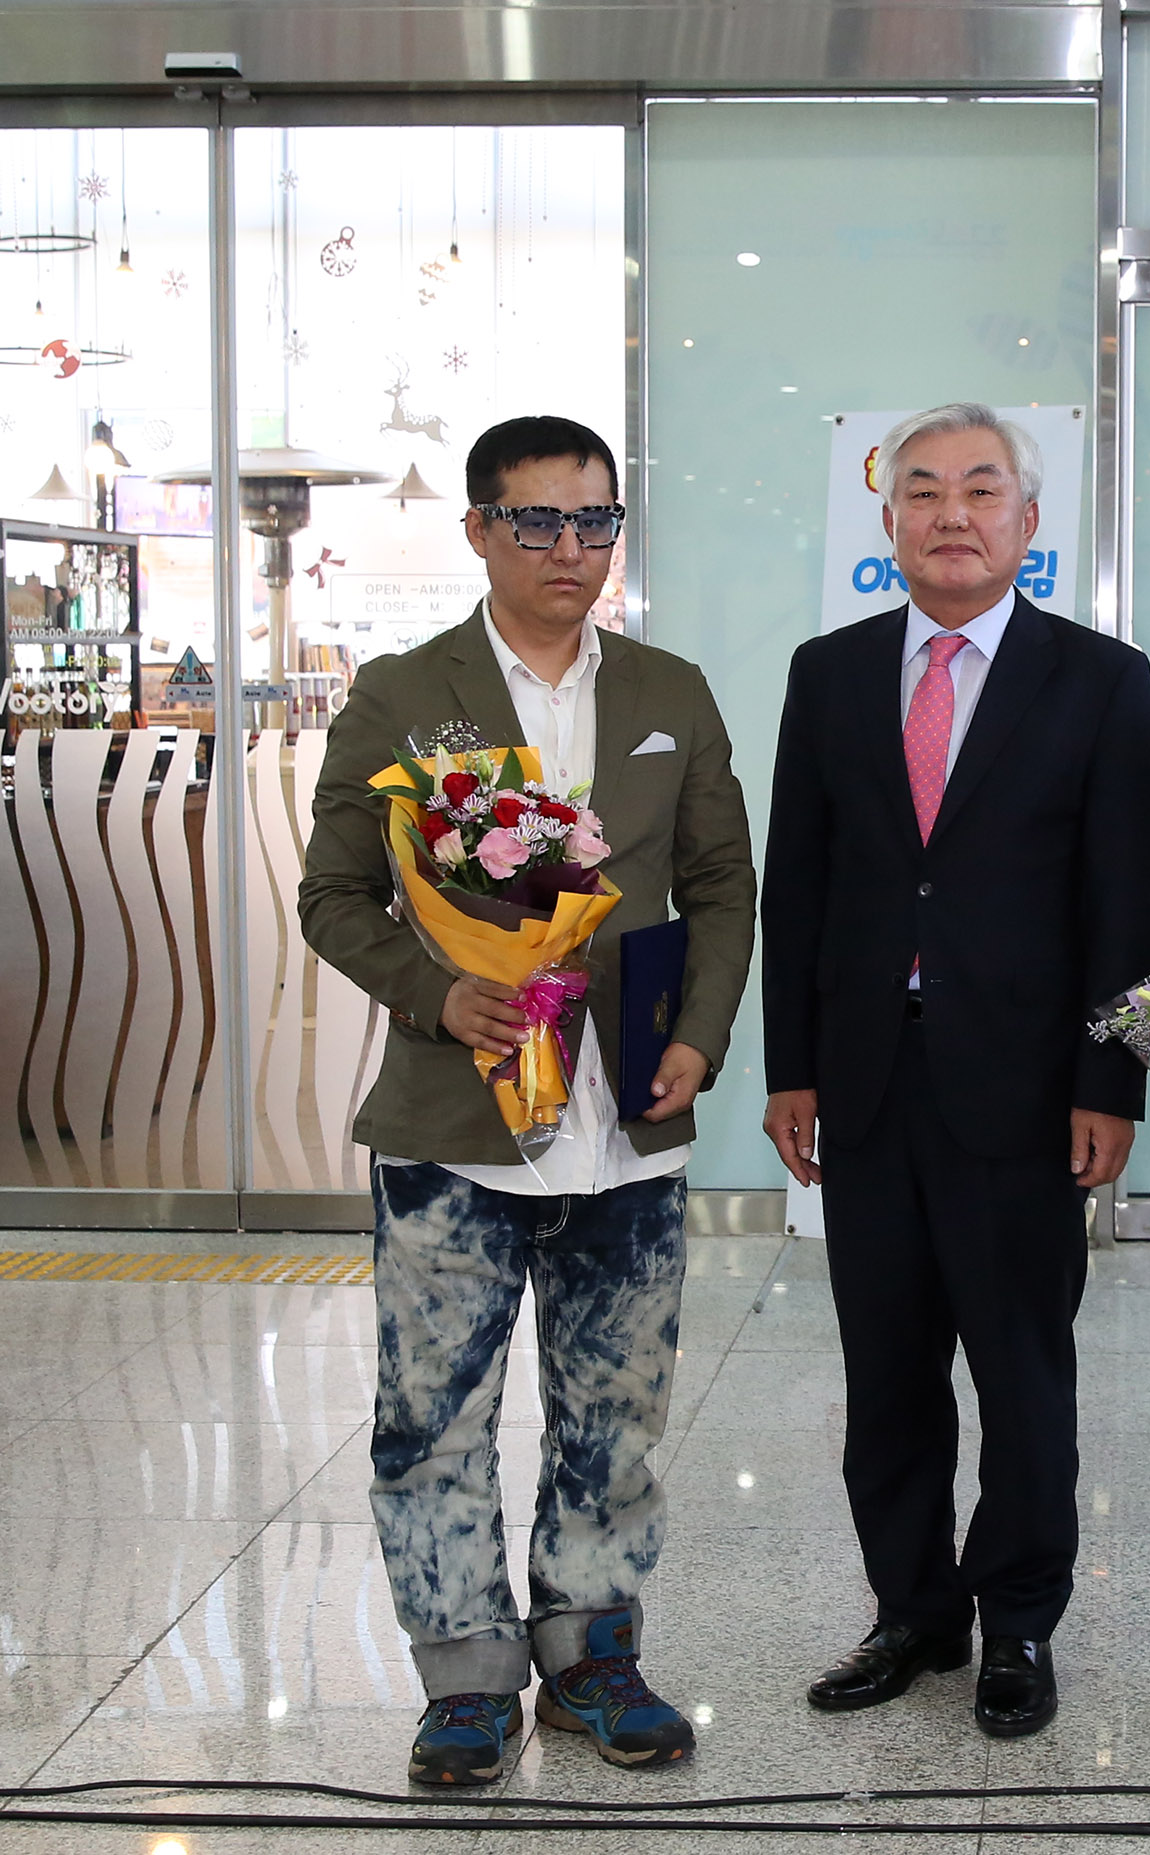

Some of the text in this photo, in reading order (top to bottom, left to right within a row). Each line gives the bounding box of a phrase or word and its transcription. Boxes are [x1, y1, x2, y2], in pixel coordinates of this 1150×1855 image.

[365, 584, 401, 595] OPEN
[11, 615, 52, 626] Mon-Fri
[10, 628, 29, 639] AM
[0, 678, 122, 722] ootory
